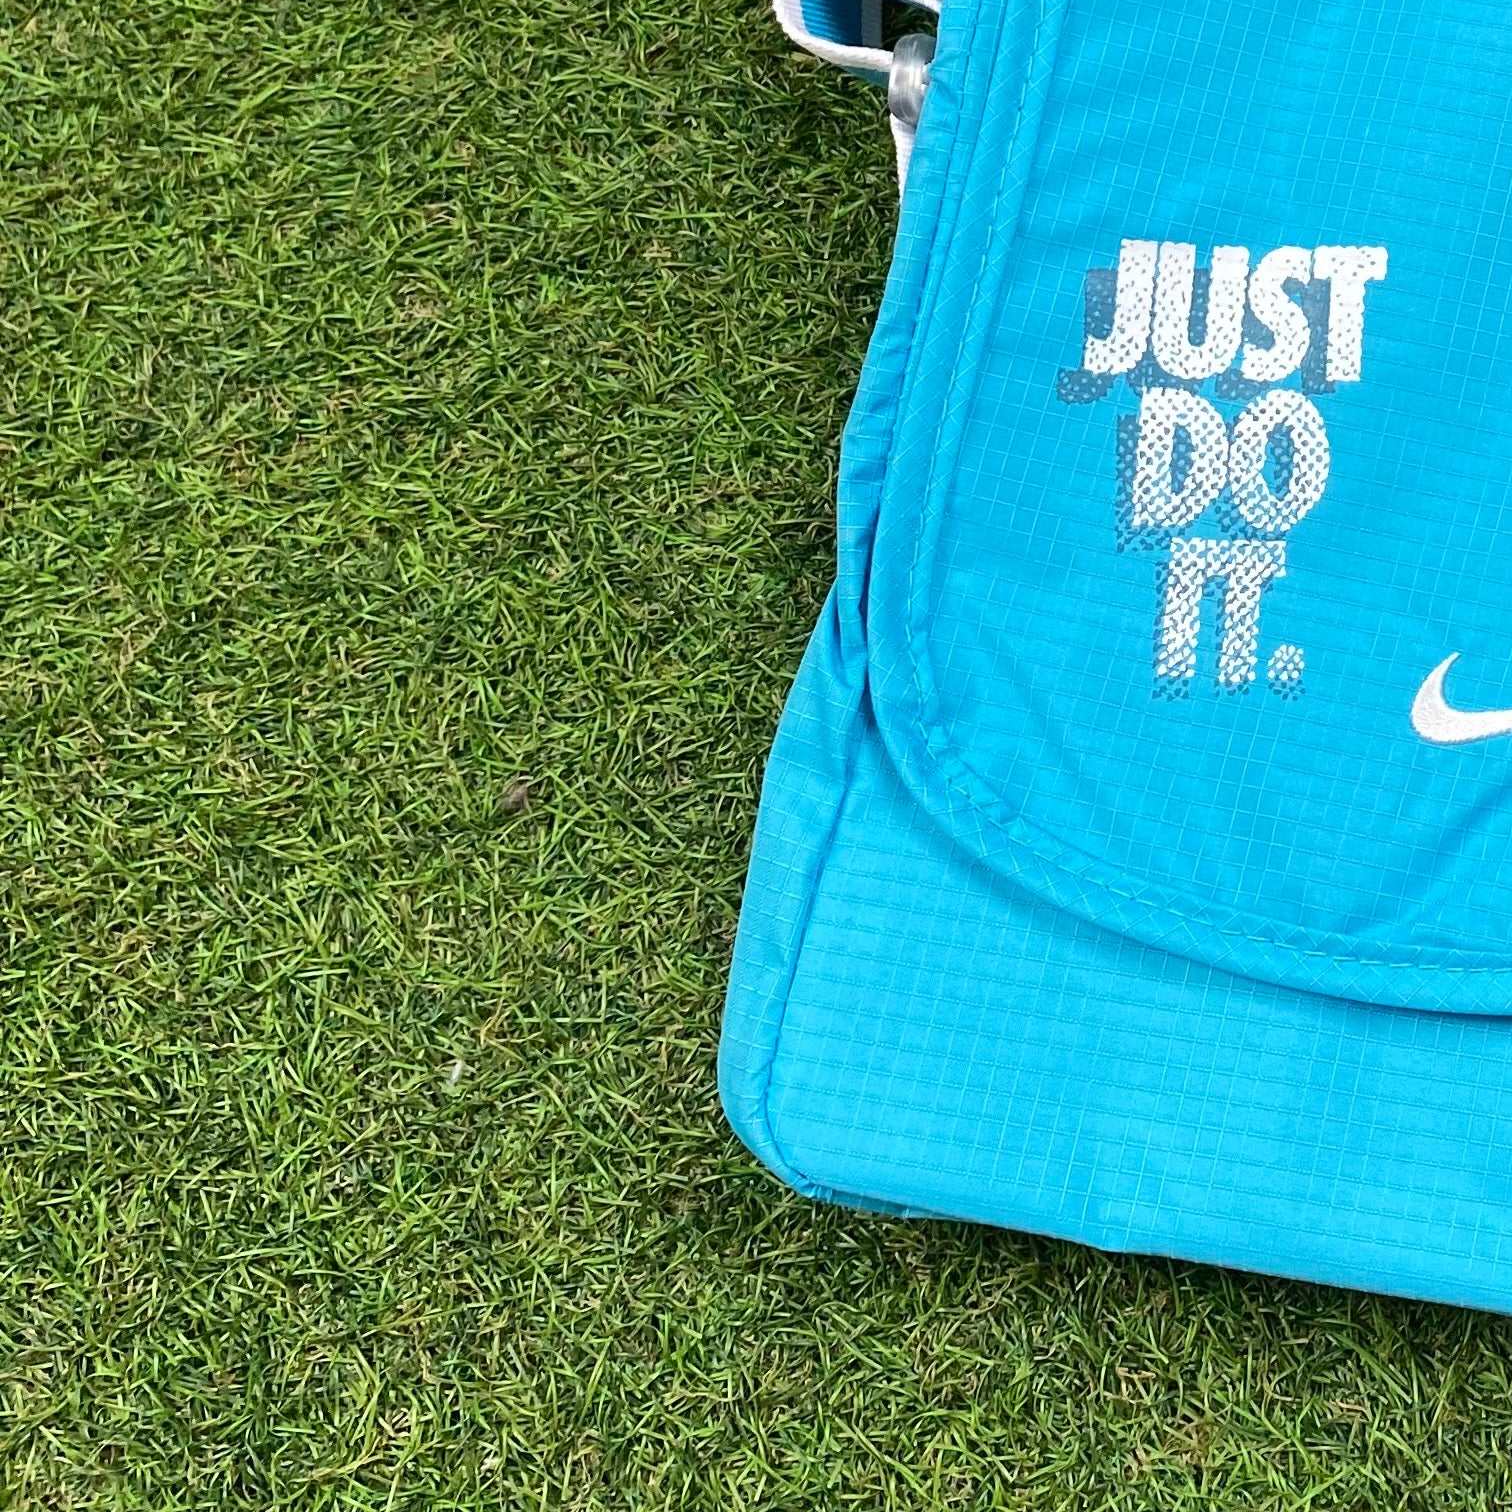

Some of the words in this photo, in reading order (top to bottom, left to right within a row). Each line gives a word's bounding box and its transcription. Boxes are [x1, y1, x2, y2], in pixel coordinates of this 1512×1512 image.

[1083, 238, 1389, 382] JUST
[1132, 387, 1330, 533] DO
[1157, 537, 1305, 684] IT.
